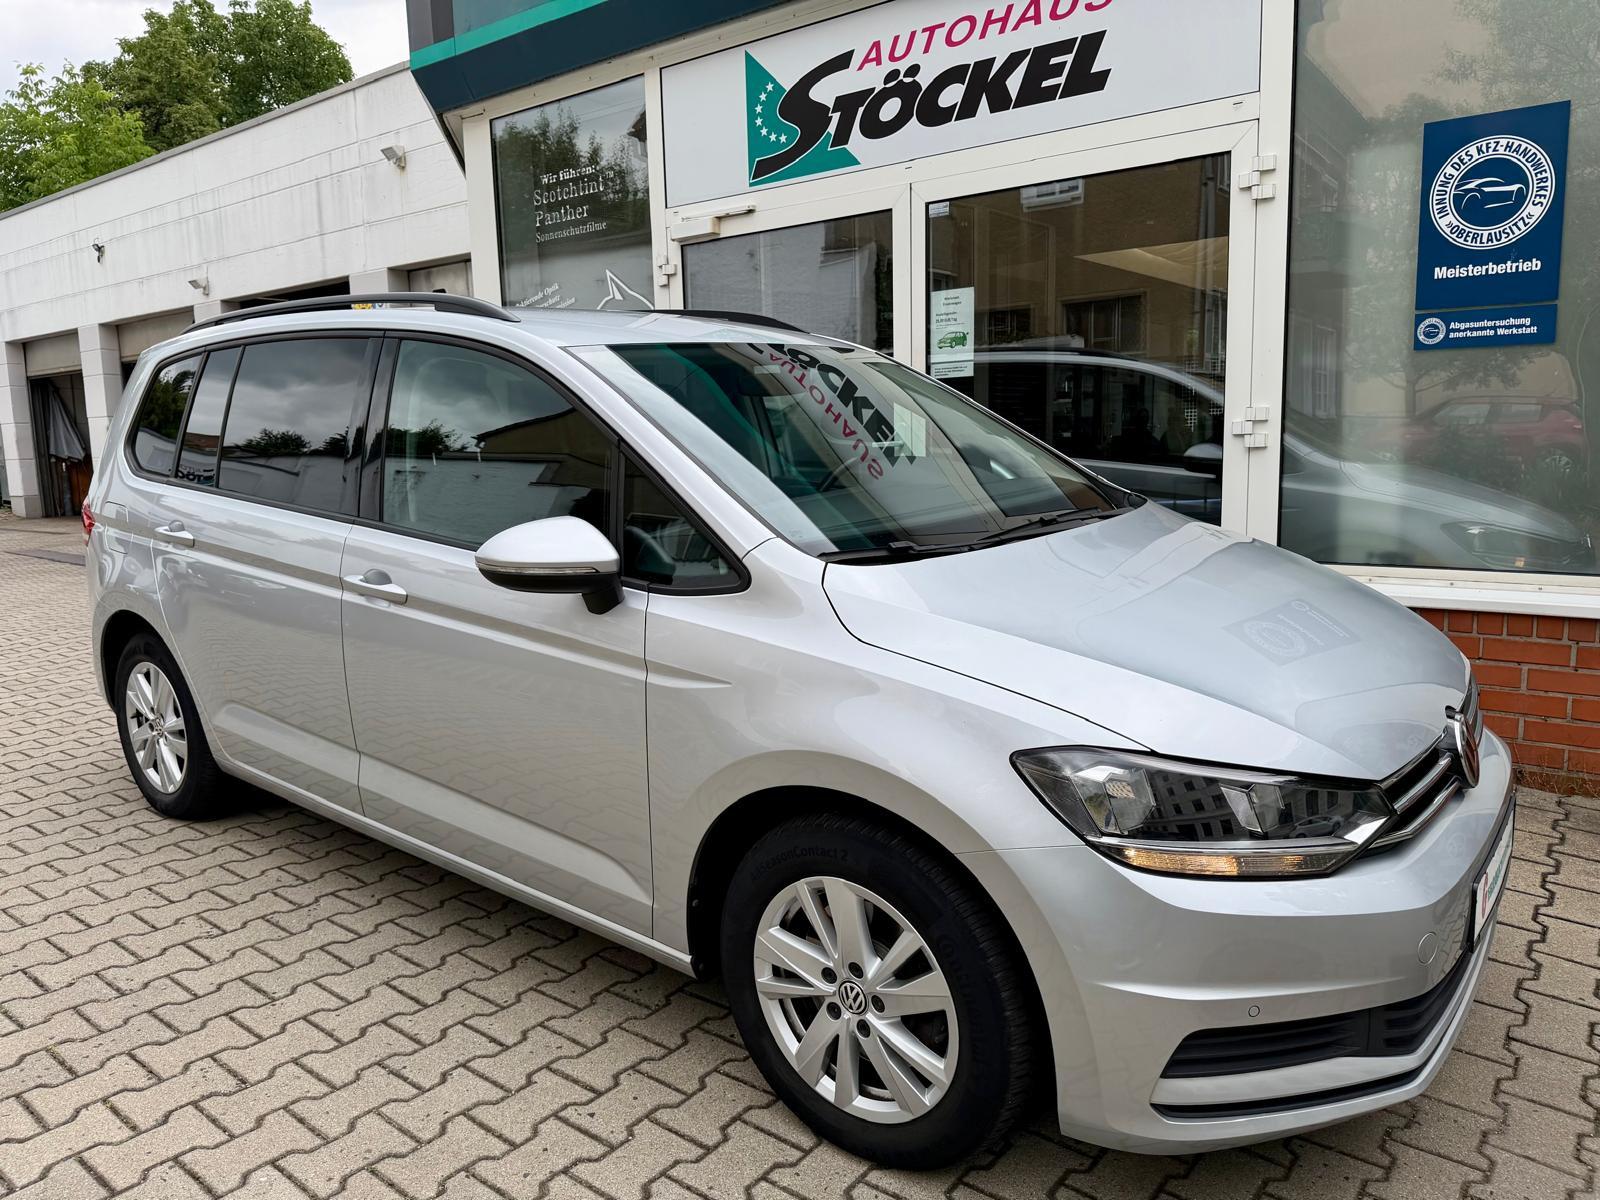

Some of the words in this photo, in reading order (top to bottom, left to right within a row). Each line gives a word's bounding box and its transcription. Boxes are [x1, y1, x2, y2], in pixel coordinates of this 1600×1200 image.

[750, 29, 1112, 182] STÖCKEL
[540, 173, 558, 185] Wir
[559, 165, 596, 181] führen:
[1435, 171, 1455, 220] INNUNG
[1450, 150, 1474, 172] DES
[1475, 140, 1549, 208] KFZ-HANDWERKES
[535, 205, 590, 227] Panther
[535, 221, 607, 243] Sonnenschutzfilme
[1433, 258, 1542, 280] Meisterbetrieb
[1448, 329, 1495, 339] anerkannte
[1496, 326, 1538, 336] Werkstatt
[1449, 317, 1531, 330] Abgasuntersuchung
